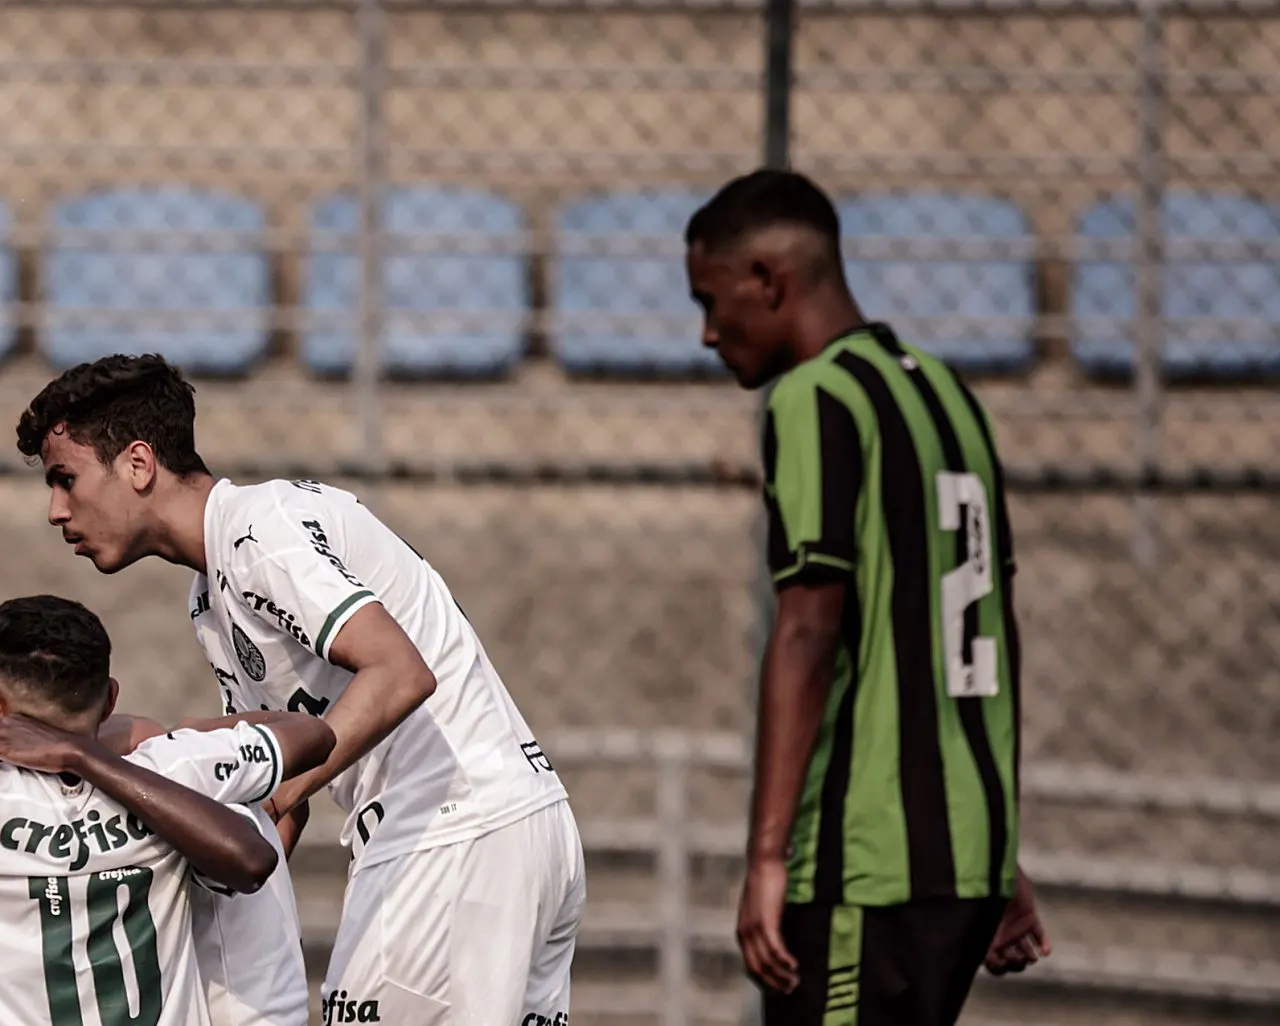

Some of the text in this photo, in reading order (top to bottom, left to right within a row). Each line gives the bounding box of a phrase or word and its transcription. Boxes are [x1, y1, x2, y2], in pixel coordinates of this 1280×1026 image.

[936, 470, 999, 697] 2
[0, 809, 157, 872] crefisa
[45, 876, 63, 916] crefisa
[98, 868, 142, 881] crefisa
